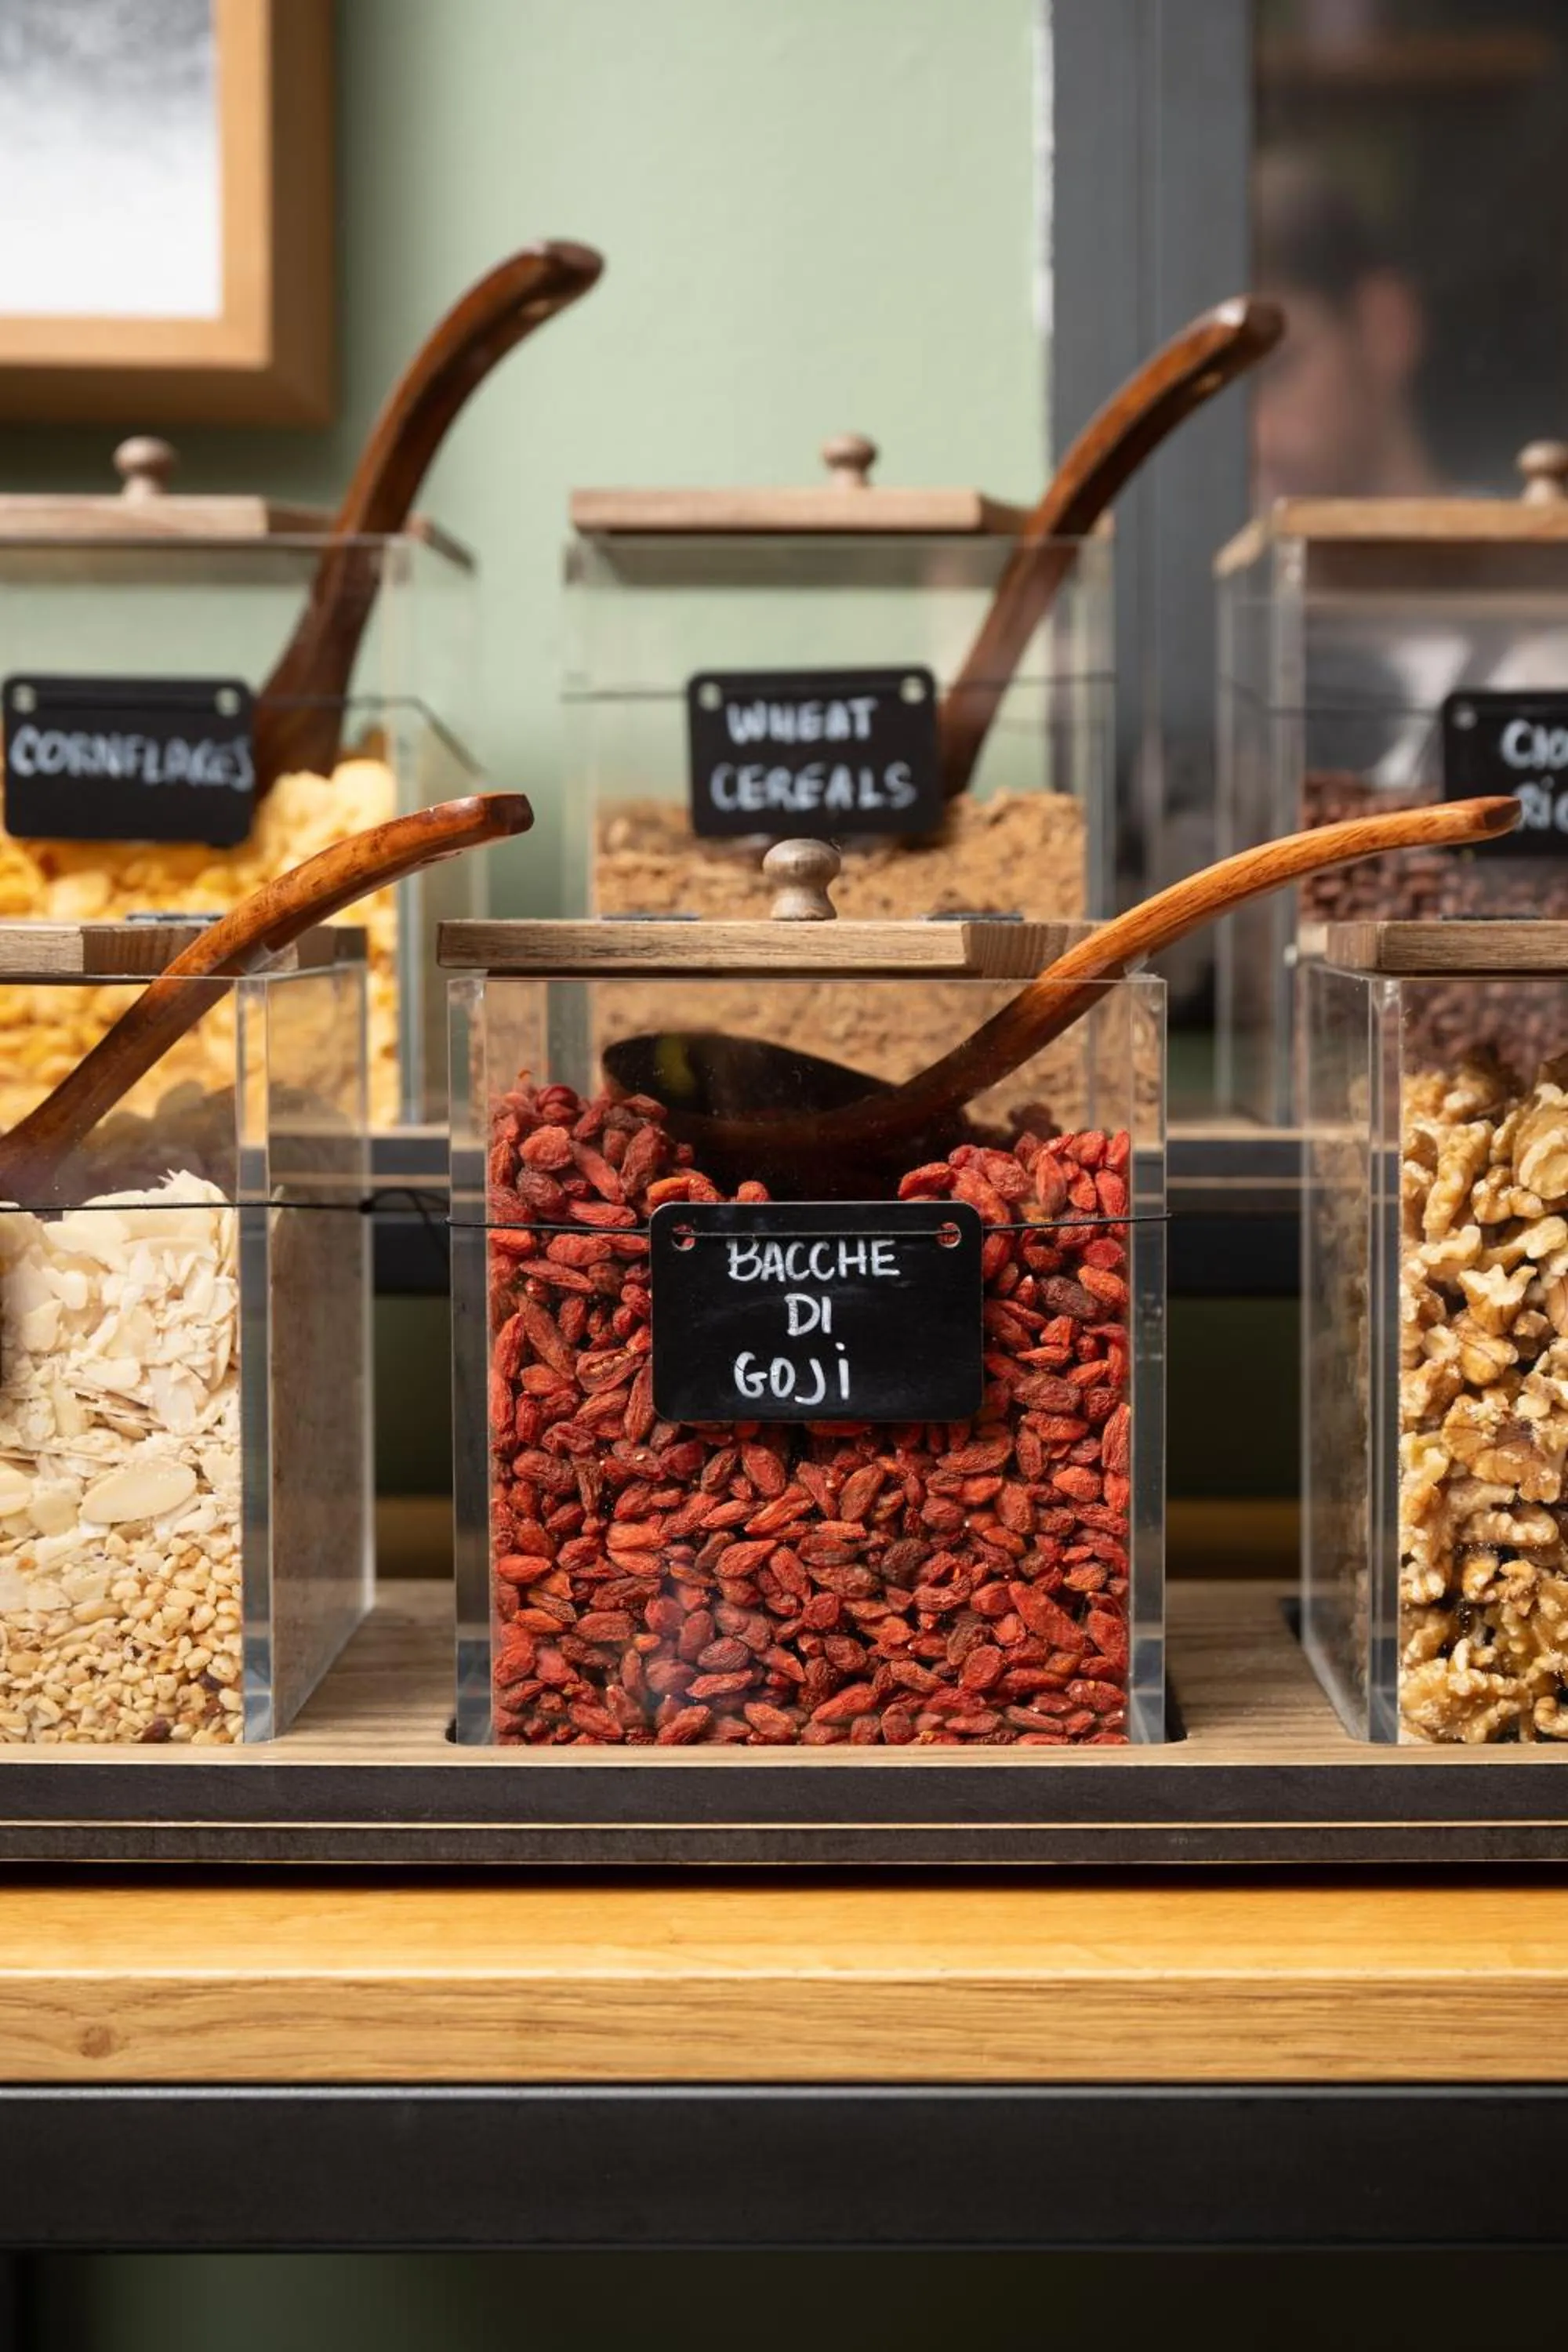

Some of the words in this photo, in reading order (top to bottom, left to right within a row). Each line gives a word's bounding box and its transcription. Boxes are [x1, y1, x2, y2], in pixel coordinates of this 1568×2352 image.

[726, 696, 877, 744] WHEAT
[710, 760, 916, 811] CEREALS
[726, 1240, 901, 1282] BACCHE
[783, 1293, 832, 1336] DI
